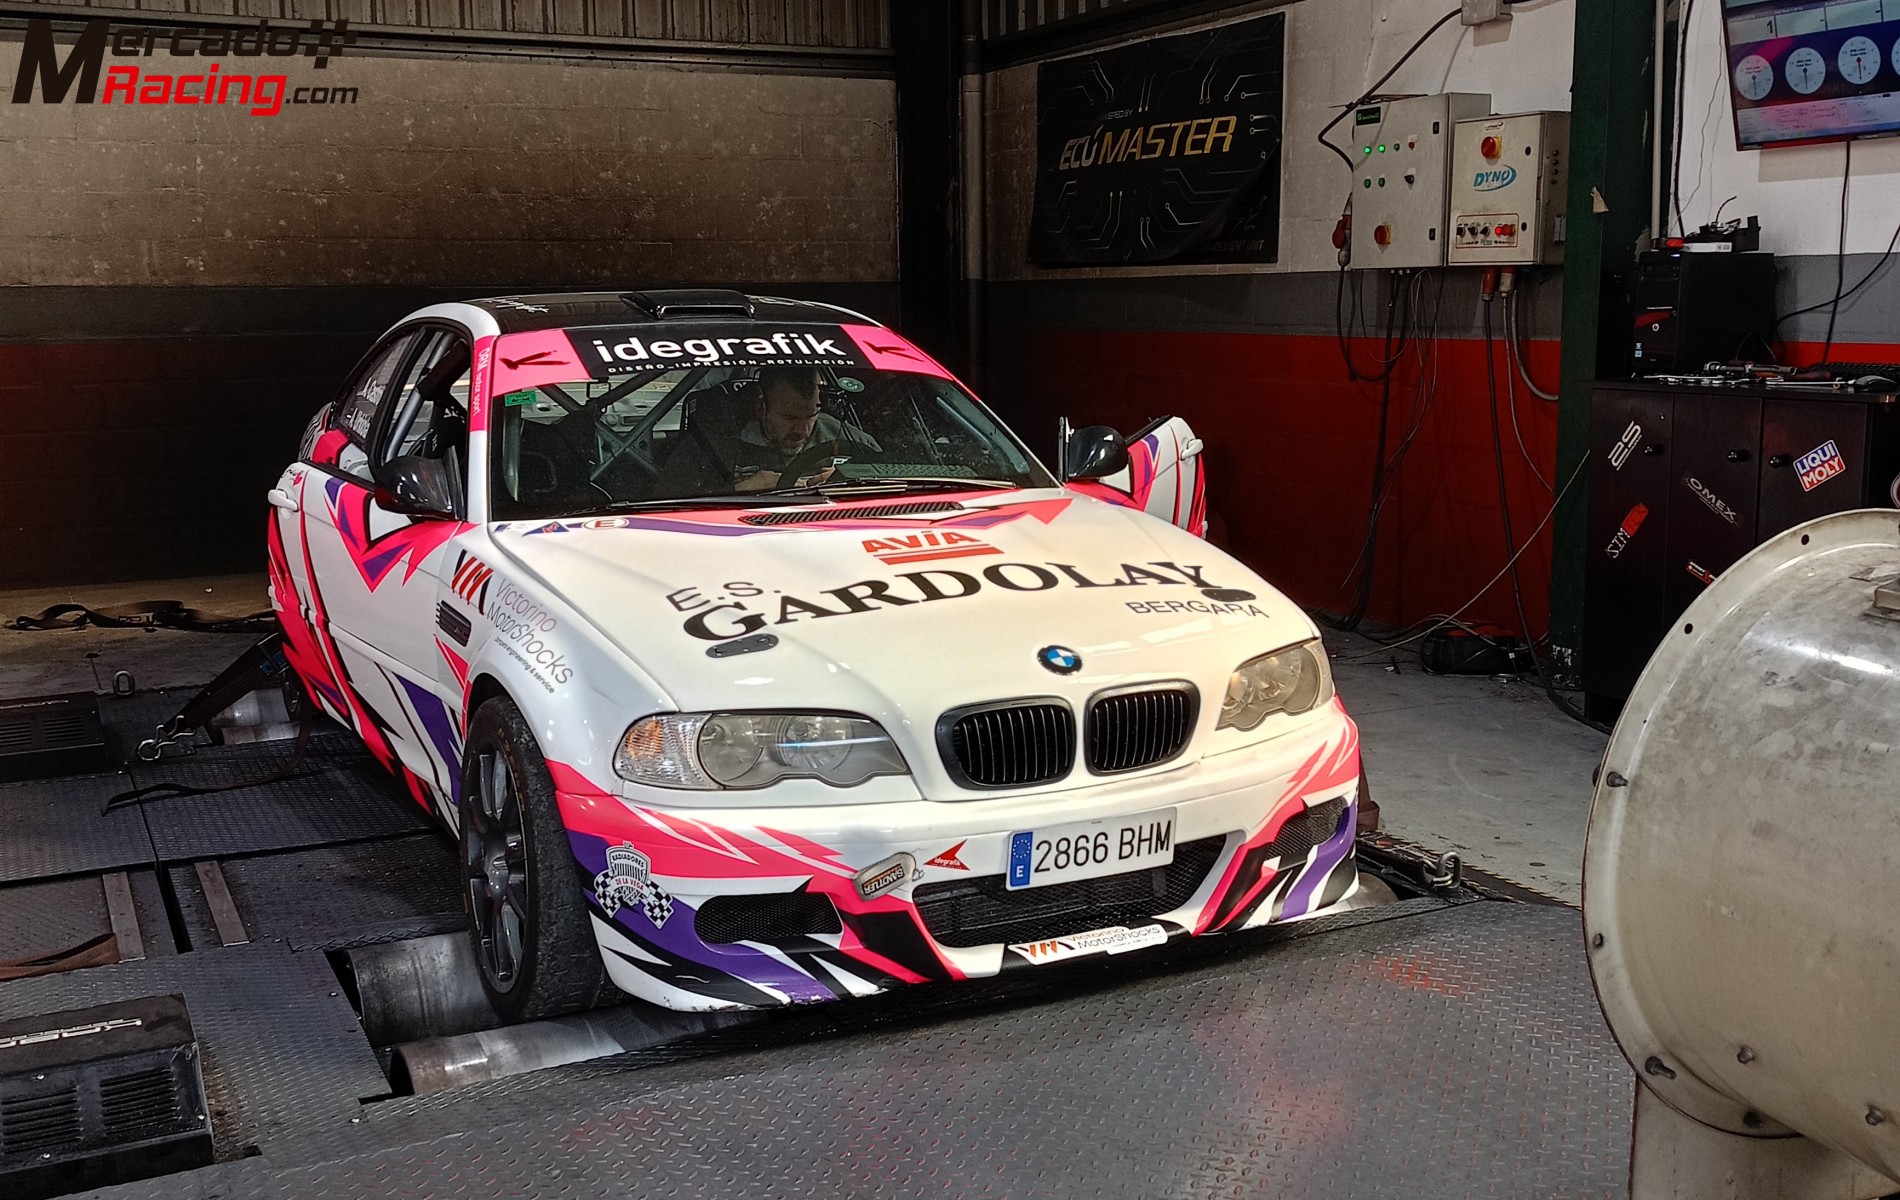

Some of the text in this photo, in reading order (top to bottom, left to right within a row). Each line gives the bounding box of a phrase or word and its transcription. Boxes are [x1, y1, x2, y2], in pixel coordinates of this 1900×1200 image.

[1473, 169, 1511, 187] DYNO
[593, 332, 847, 364] idegrafik
[1796, 442, 1836, 475] LIQUI
[1801, 457, 1843, 490] MOLY
[1689, 477, 1737, 520] OMEX
[495, 578, 558, 632] Victorino
[666, 580, 782, 612] E.S.
[683, 561, 1213, 641] GARDOLAY
[1124, 600, 1271, 619] BERGARA
[486, 601, 574, 684] MotorShocks
[505, 645, 531, 671] engineering
[533, 670, 555, 693] service
[1034, 819, 1173, 874] 2866 BHM
[615, 877, 645, 891] DE LA VEGA
[864, 868, 904, 895] SANDTLER
[1016, 865, 1025, 877] E
[1077, 926, 1161, 950] MotorShocks
